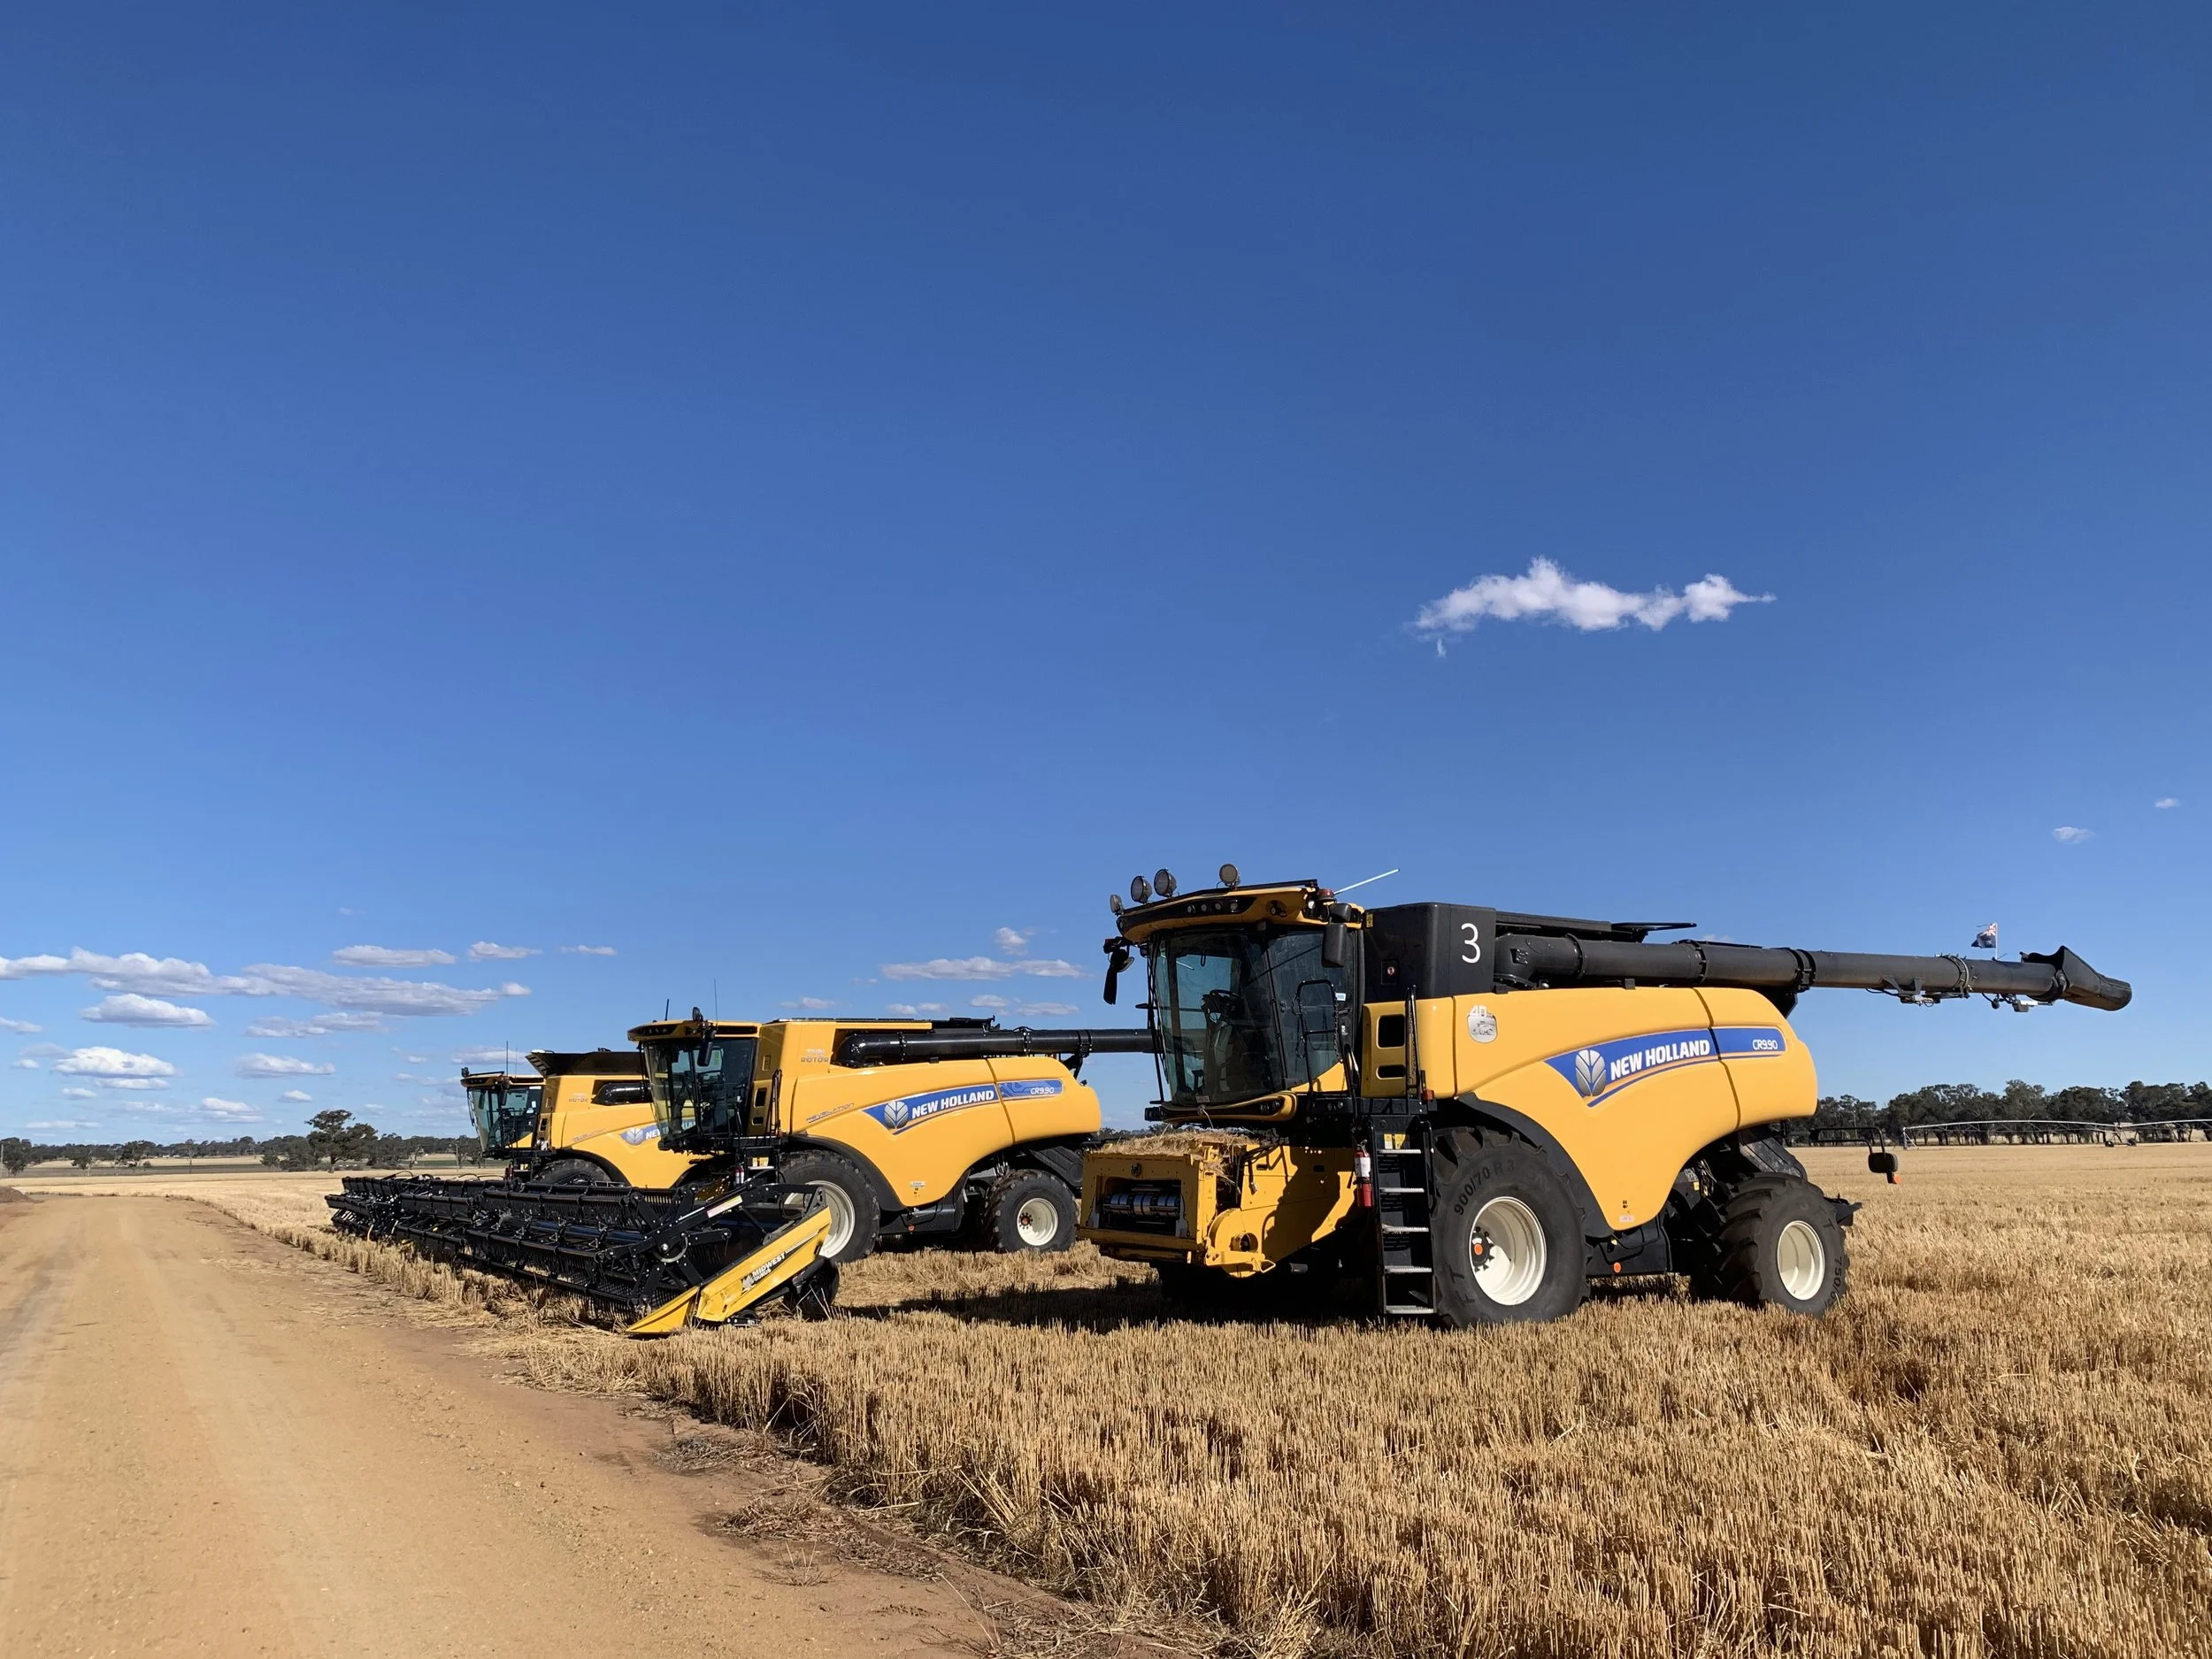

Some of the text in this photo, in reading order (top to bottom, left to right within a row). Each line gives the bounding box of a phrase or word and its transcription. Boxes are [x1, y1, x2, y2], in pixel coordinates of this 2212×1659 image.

[1461, 923, 1481, 964] 3
[1610, 1040, 1710, 1080] NEW HOLLAND
[912, 1090, 995, 1119] NEW HOLLAND
[1454, 1167, 1490, 1216] 900/70
[752, 1252, 786, 1278] MIDWEST
